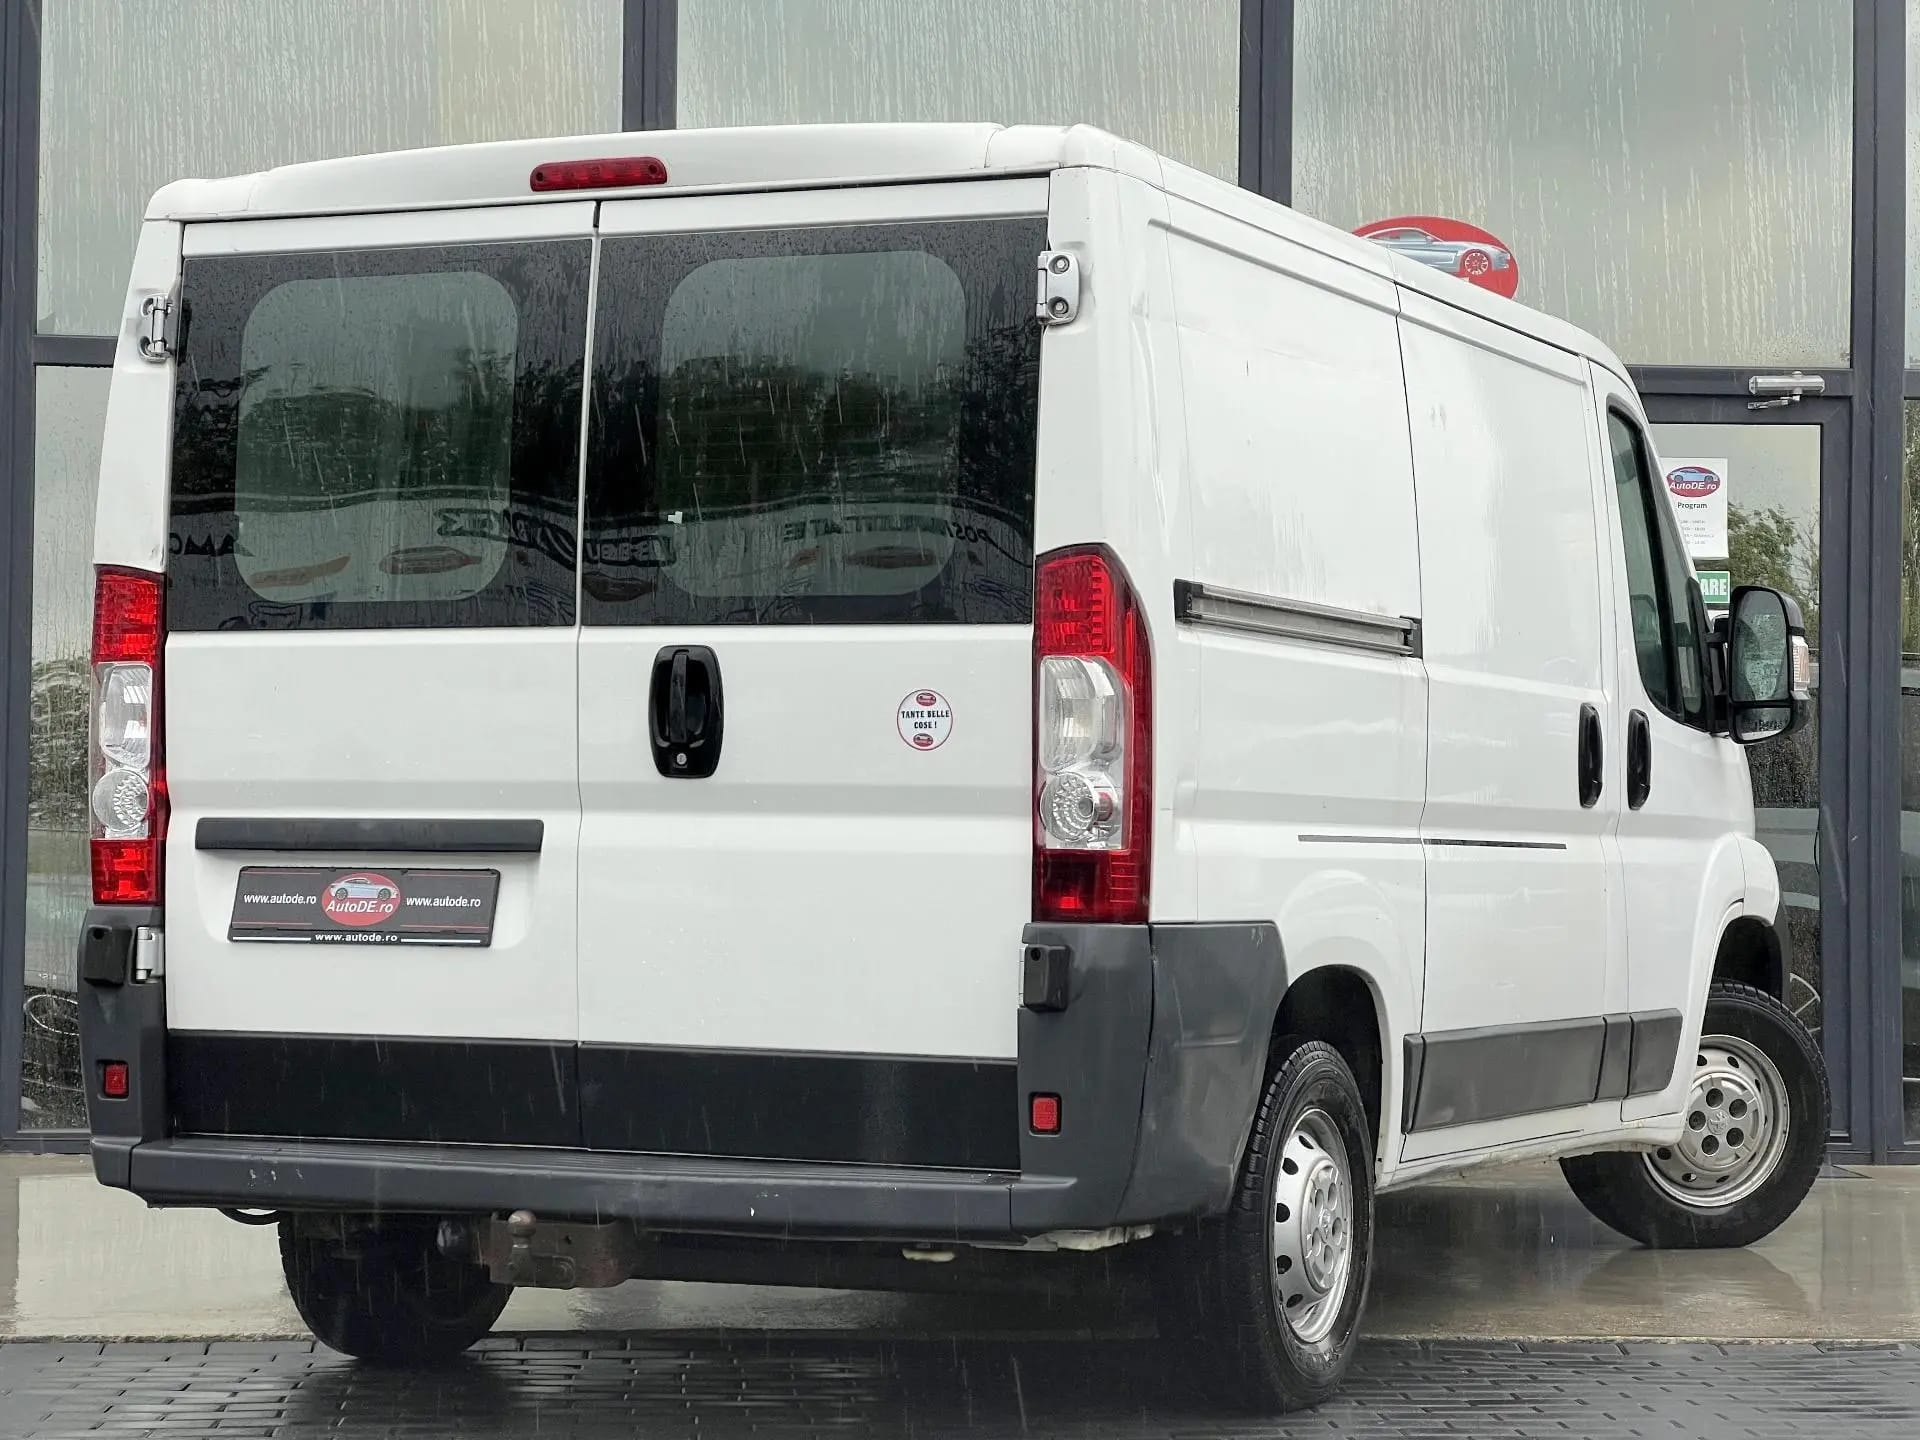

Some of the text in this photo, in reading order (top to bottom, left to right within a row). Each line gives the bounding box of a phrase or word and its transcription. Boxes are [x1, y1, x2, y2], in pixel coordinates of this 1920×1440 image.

[1670, 482, 1717, 490] AutoDE.ro
[927, 710, 950, 718] BELLE
[914, 721, 933, 729] COSE
[243, 892, 317, 905] www.autode.ro
[405, 895, 481, 908] www.autode.ro
[325, 899, 394, 914] AutoDE.ro
[315, 931, 398, 942] www.autode.ro
